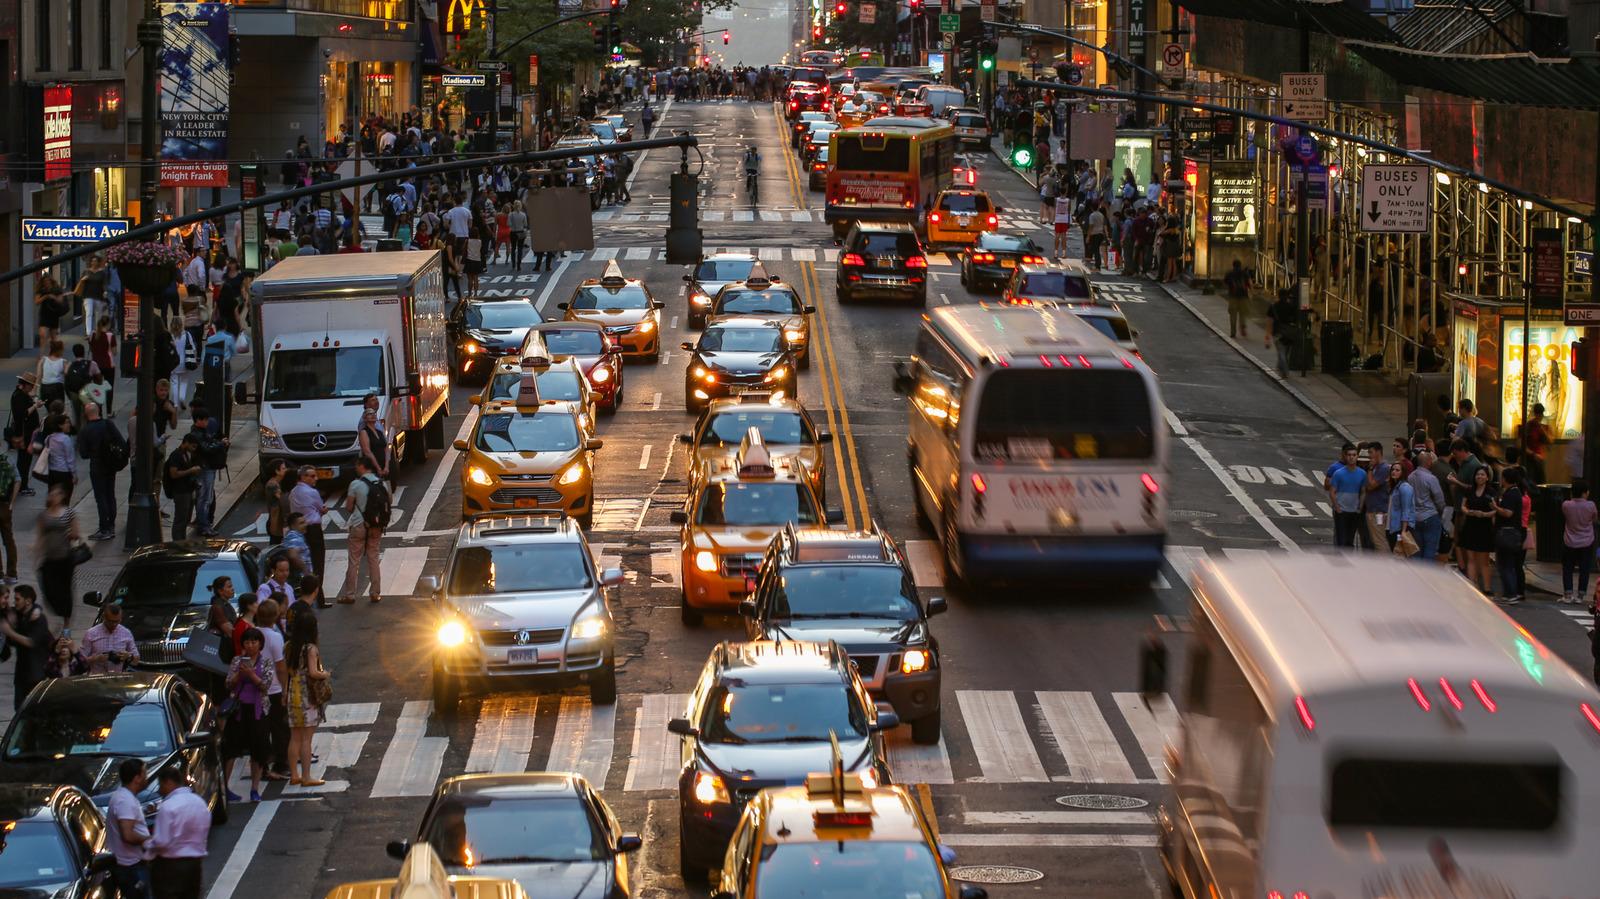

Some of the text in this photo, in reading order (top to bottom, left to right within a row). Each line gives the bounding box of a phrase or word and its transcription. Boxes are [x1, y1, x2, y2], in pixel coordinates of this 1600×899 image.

[1130, 0, 1143, 36] TM
[1289, 78, 1319, 86] BUSES
[161, 171, 214, 181] Knight Frank
[1375, 171, 1418, 181] BUSES
[1379, 186, 1412, 196] ONLY
[25, 224, 126, 238] Vanderbilt Ave
[1571, 310, 1592, 319] ONE
[1509, 327, 1579, 344] GET A
